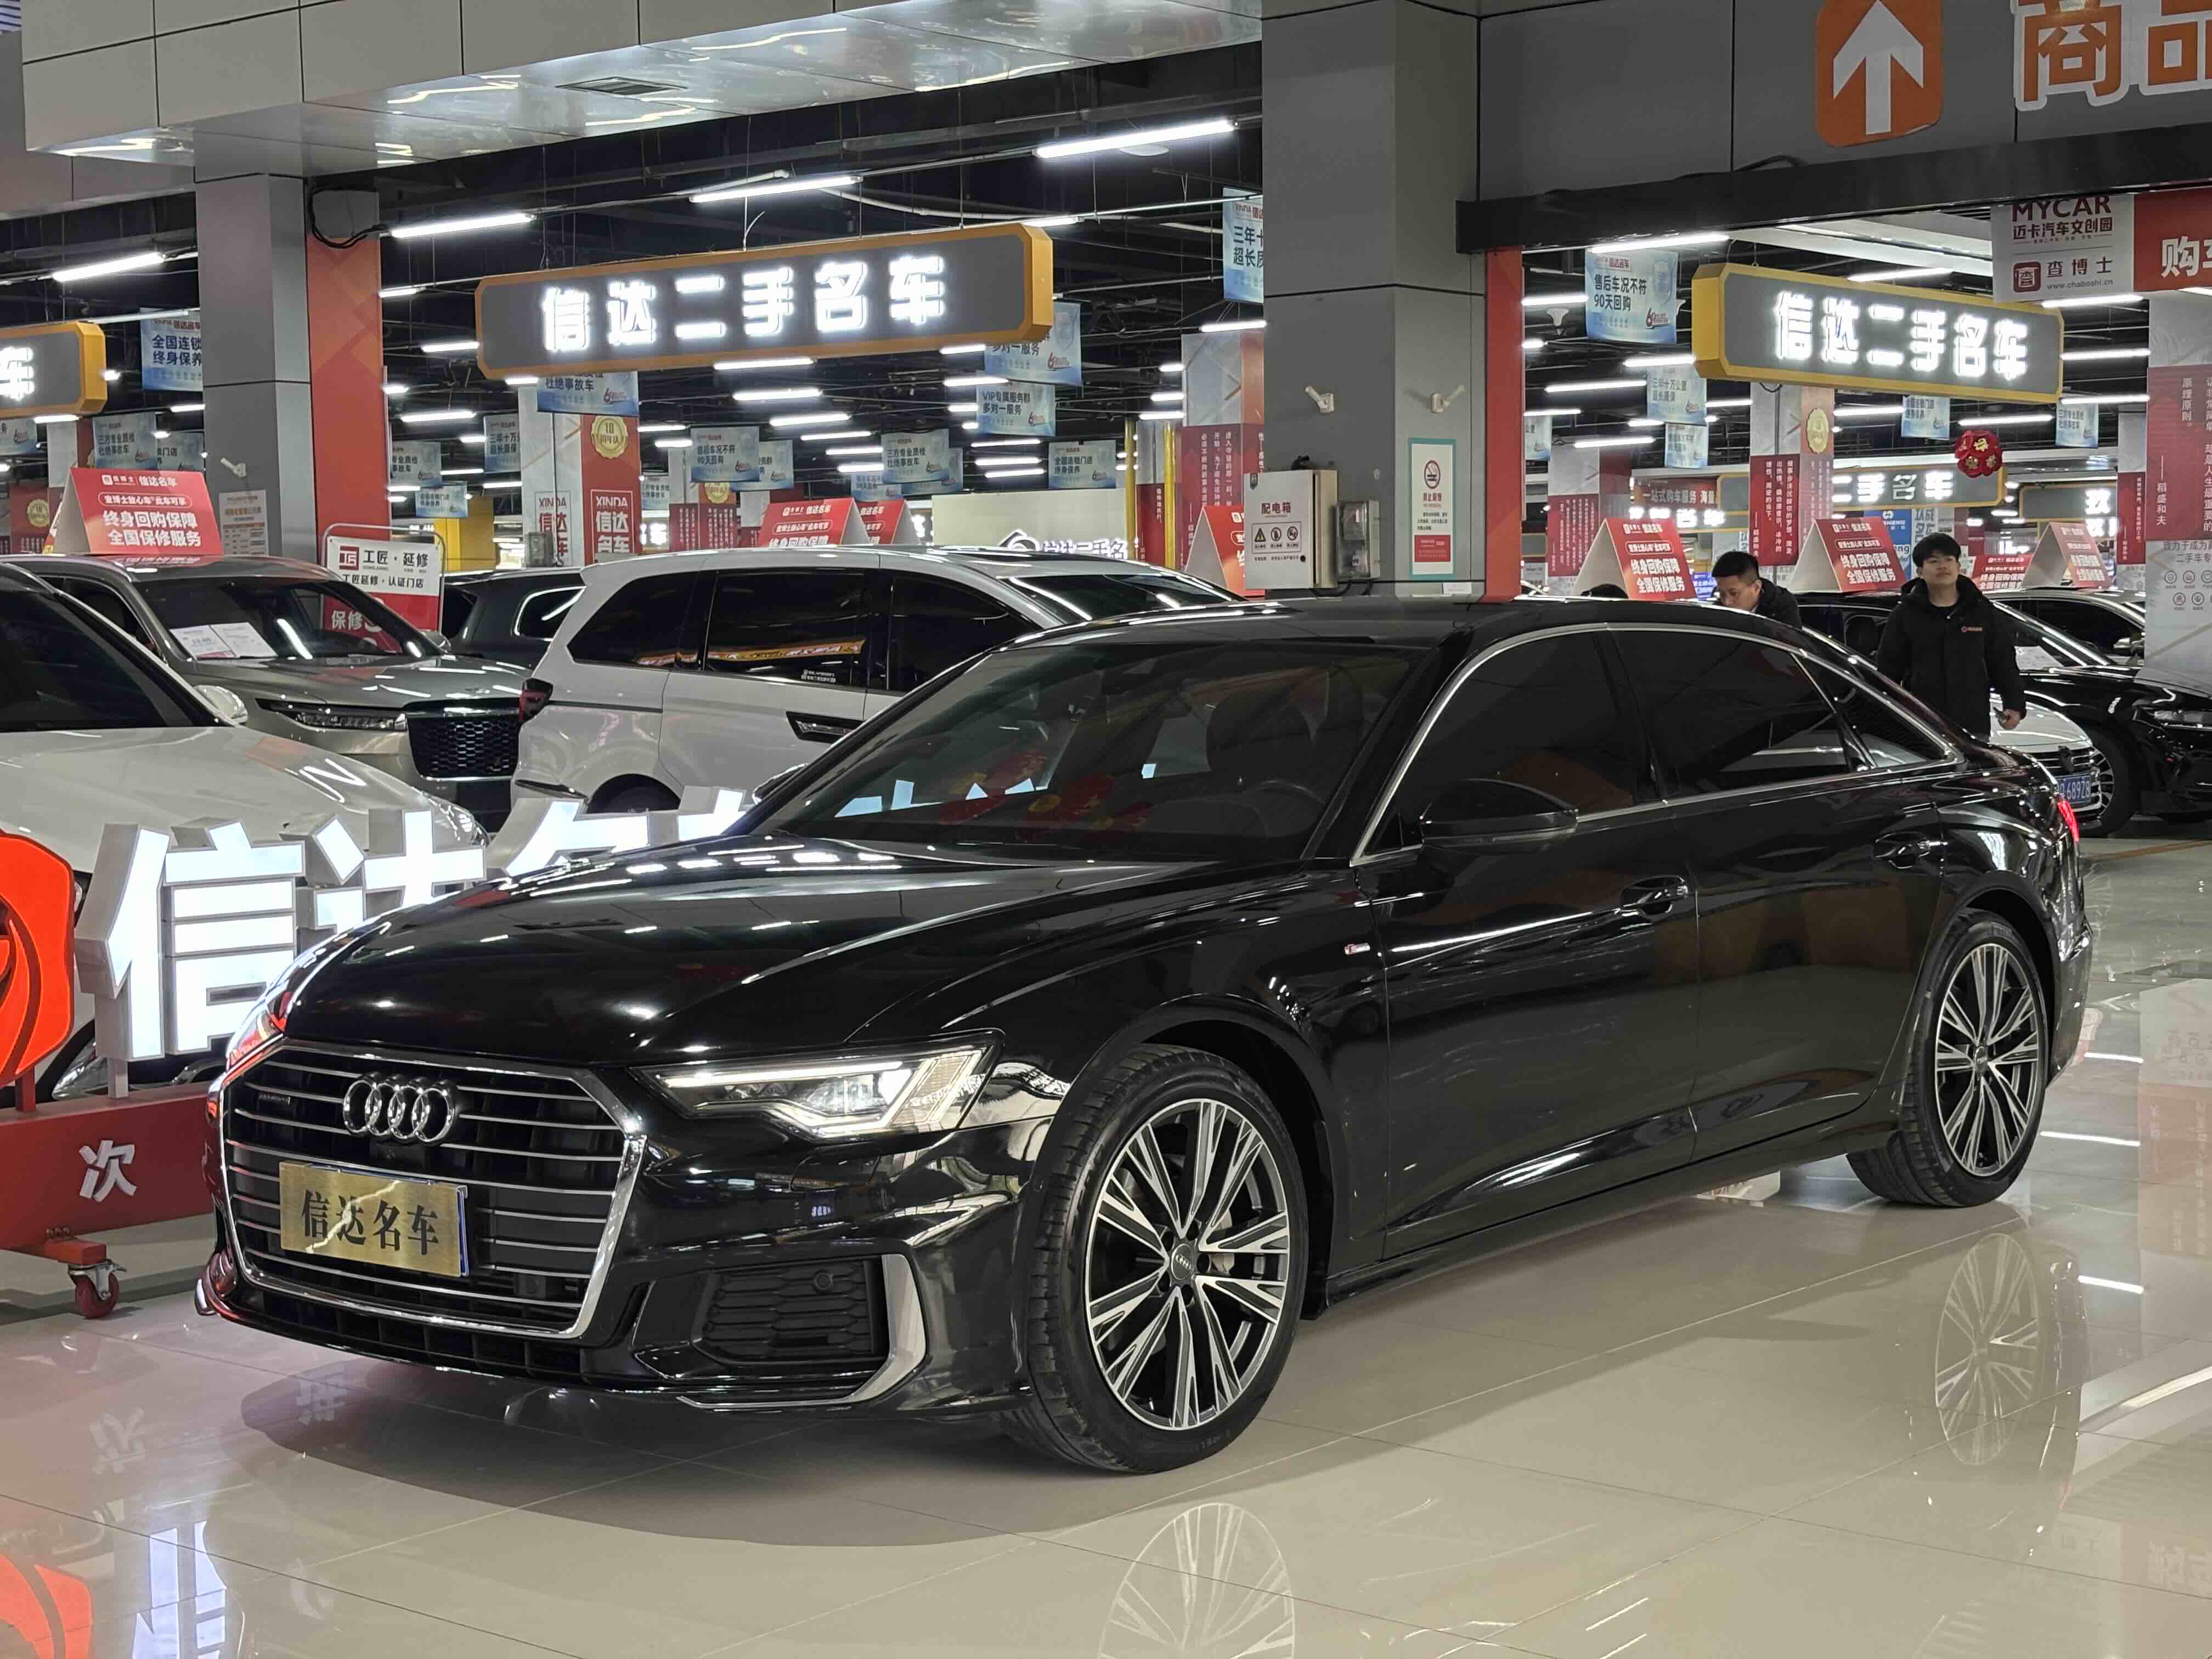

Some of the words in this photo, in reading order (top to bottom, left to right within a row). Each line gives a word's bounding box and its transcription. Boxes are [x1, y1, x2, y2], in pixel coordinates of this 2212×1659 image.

[2012, 196, 2112, 222] MYCAR
[2013, 216, 2113, 240] 迈卡汽车文创园
[2047, 256, 2113, 278] 查博士
[1594, 274, 1647, 295] 售后车况不符
[2047, 279, 2113, 291] www.chaboshi.cn
[542, 256, 945, 352] 信达二手名车
[1594, 294, 1632, 311] 90天回购
[152, 335, 201, 350] 全国连锁
[1776, 289, 2029, 381] 信达二手名车
[153, 351, 201, 366] 终身保养
[596, 495, 628, 507] XINDA
[1261, 501, 1291, 515] 配电箱
[103, 510, 198, 528] 终身回购保障
[596, 510, 629, 533] 信达
[108, 529, 202, 547] 全国保修服务
[78, 1139, 138, 1203] 次
[301, 1189, 439, 1256] 信达名车
